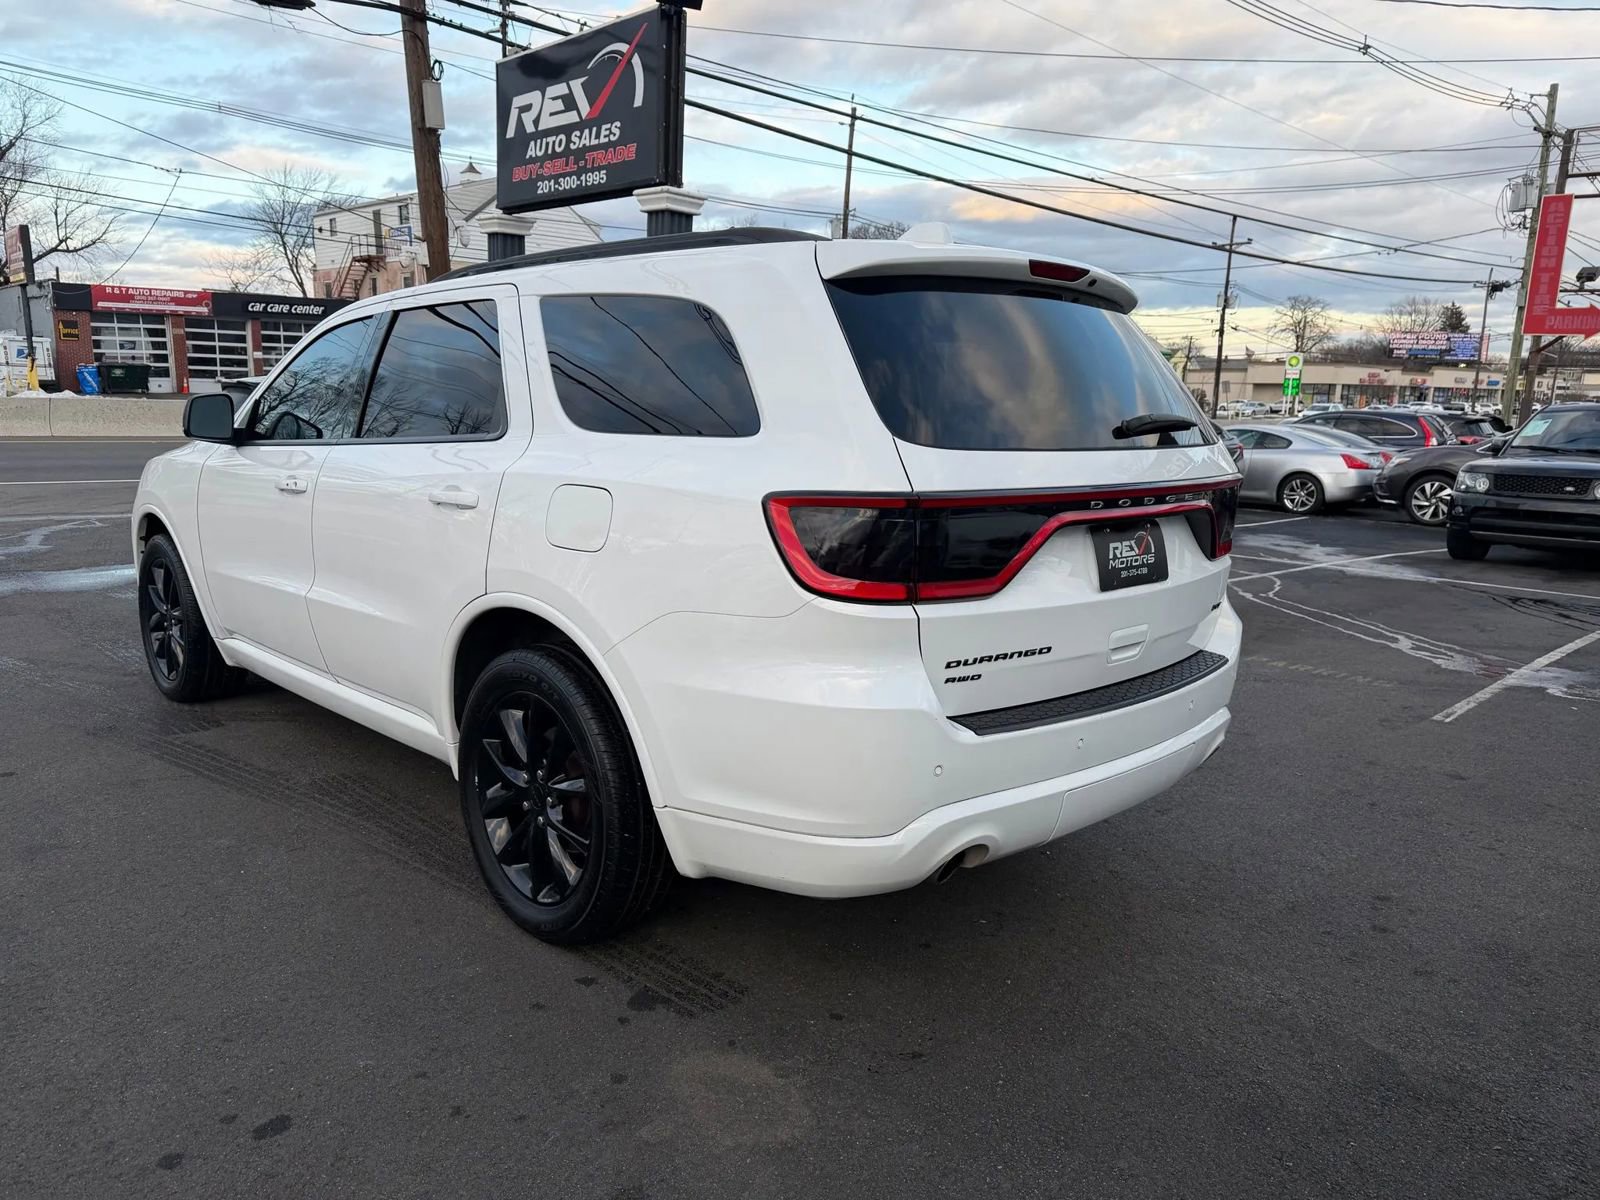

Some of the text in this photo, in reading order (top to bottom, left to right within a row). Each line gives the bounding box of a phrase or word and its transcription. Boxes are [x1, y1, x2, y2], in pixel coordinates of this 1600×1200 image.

[526, 121, 621, 159] AUTO SALES
[537, 170, 607, 194] 201-300-1995
[128, 288, 150, 296] AUTO
[151, 289, 185, 298] REPAIRS
[248, 302, 325, 315] car care center
[1545, 315, 1600, 330] PARKIN
[1090, 494, 1195, 509] DODGE
[1108, 553, 1155, 570] MOTORS
[944, 646, 1052, 669] DURANGO
[944, 674, 982, 684] AWD
